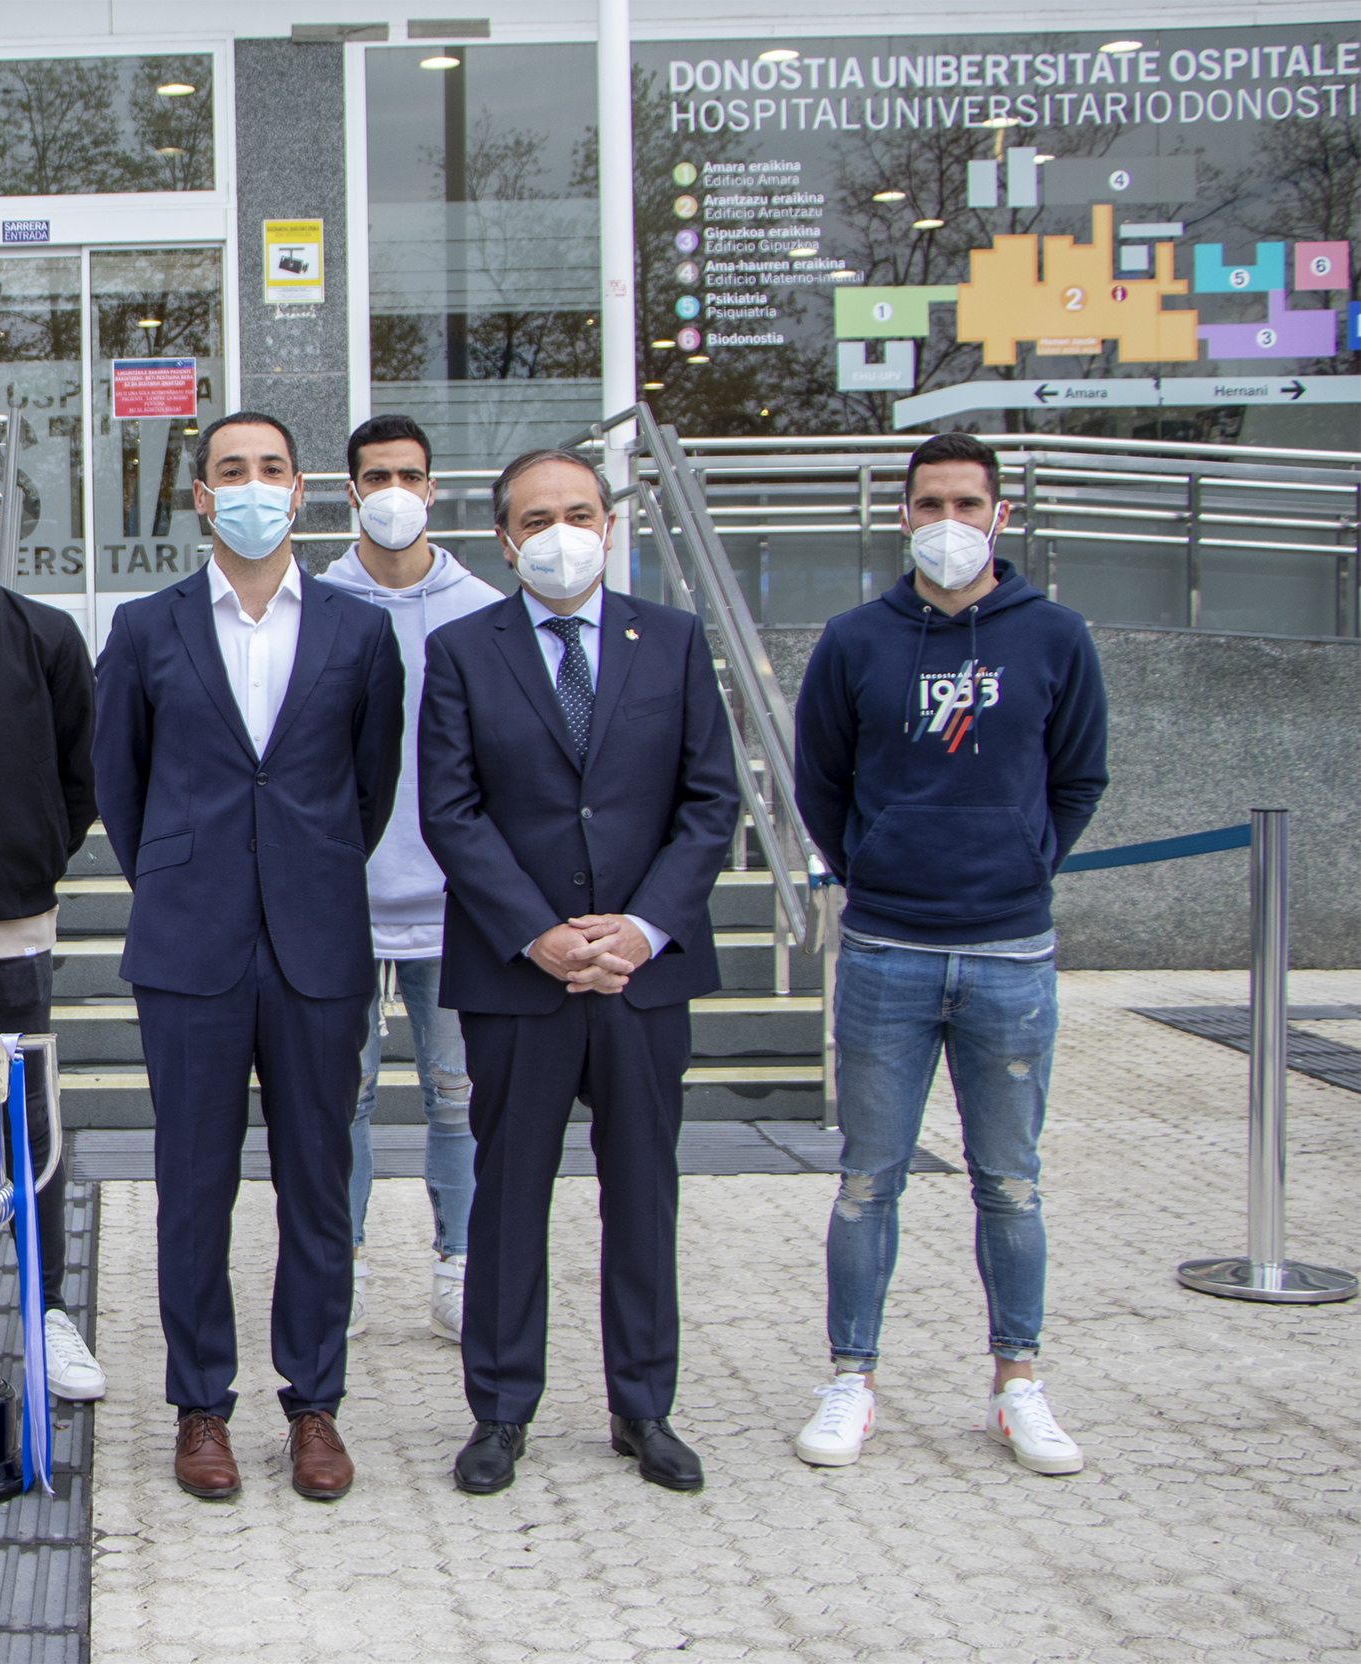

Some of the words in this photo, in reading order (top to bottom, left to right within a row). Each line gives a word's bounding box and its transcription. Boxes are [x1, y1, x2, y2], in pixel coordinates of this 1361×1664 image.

[669, 56, 865, 93] DONOSTIA
[872, 50, 1161, 89] UNIBERTSITATE
[1170, 42, 1360, 83] OSPITALE
[671, 97, 861, 133] HOSPITAL
[865, 90, 1172, 131] UNIVERSITARIO
[1179, 83, 1356, 123] DONOSTI
[703, 162, 745, 173] Amara
[748, 160, 801, 172] eraikina
[704, 174, 754, 187] Edificio
[757, 174, 800, 185] Amara
[1114, 173, 1125, 187] 4
[703, 194, 768, 206] Arantzazu
[771, 192, 824, 204] eraikina
[680, 199, 692, 214] 2
[704, 207, 755, 220] Edificio
[758, 206, 823, 219] Arantzazu
[4, 221, 47, 232] SARRERA
[704, 227, 765, 240] Gipuzkoa
[768, 225, 821, 238] eraikina
[4, 231, 48, 242] ENTRADA
[680, 232, 693, 248] 3
[705, 240, 756, 253] Edificio
[758, 239, 820, 252] Gipuzkoa
[705, 259, 789, 272] Ama-haurren
[792, 257, 846, 270] eraikina
[1316, 259, 1326, 273] 6
[680, 264, 694, 280] 4
[1235, 271, 1245, 286] 5
[706, 273, 756, 286] Edificio
[706, 292, 767, 305] Psikiatria
[1065, 287, 1084, 310] 2
[682, 299, 695, 315] 5
[706, 306, 777, 320] Psiquiatría
[682, 330, 695, 347] 6
[707, 333, 784, 346] Biodonostia
[1262, 331, 1272, 345] 3
[1064, 386, 1108, 400] Amara
[1214, 384, 1268, 397] Hernani
[920, 672, 956, 680] Lacoste
[957, 671, 999, 679] Athetics
